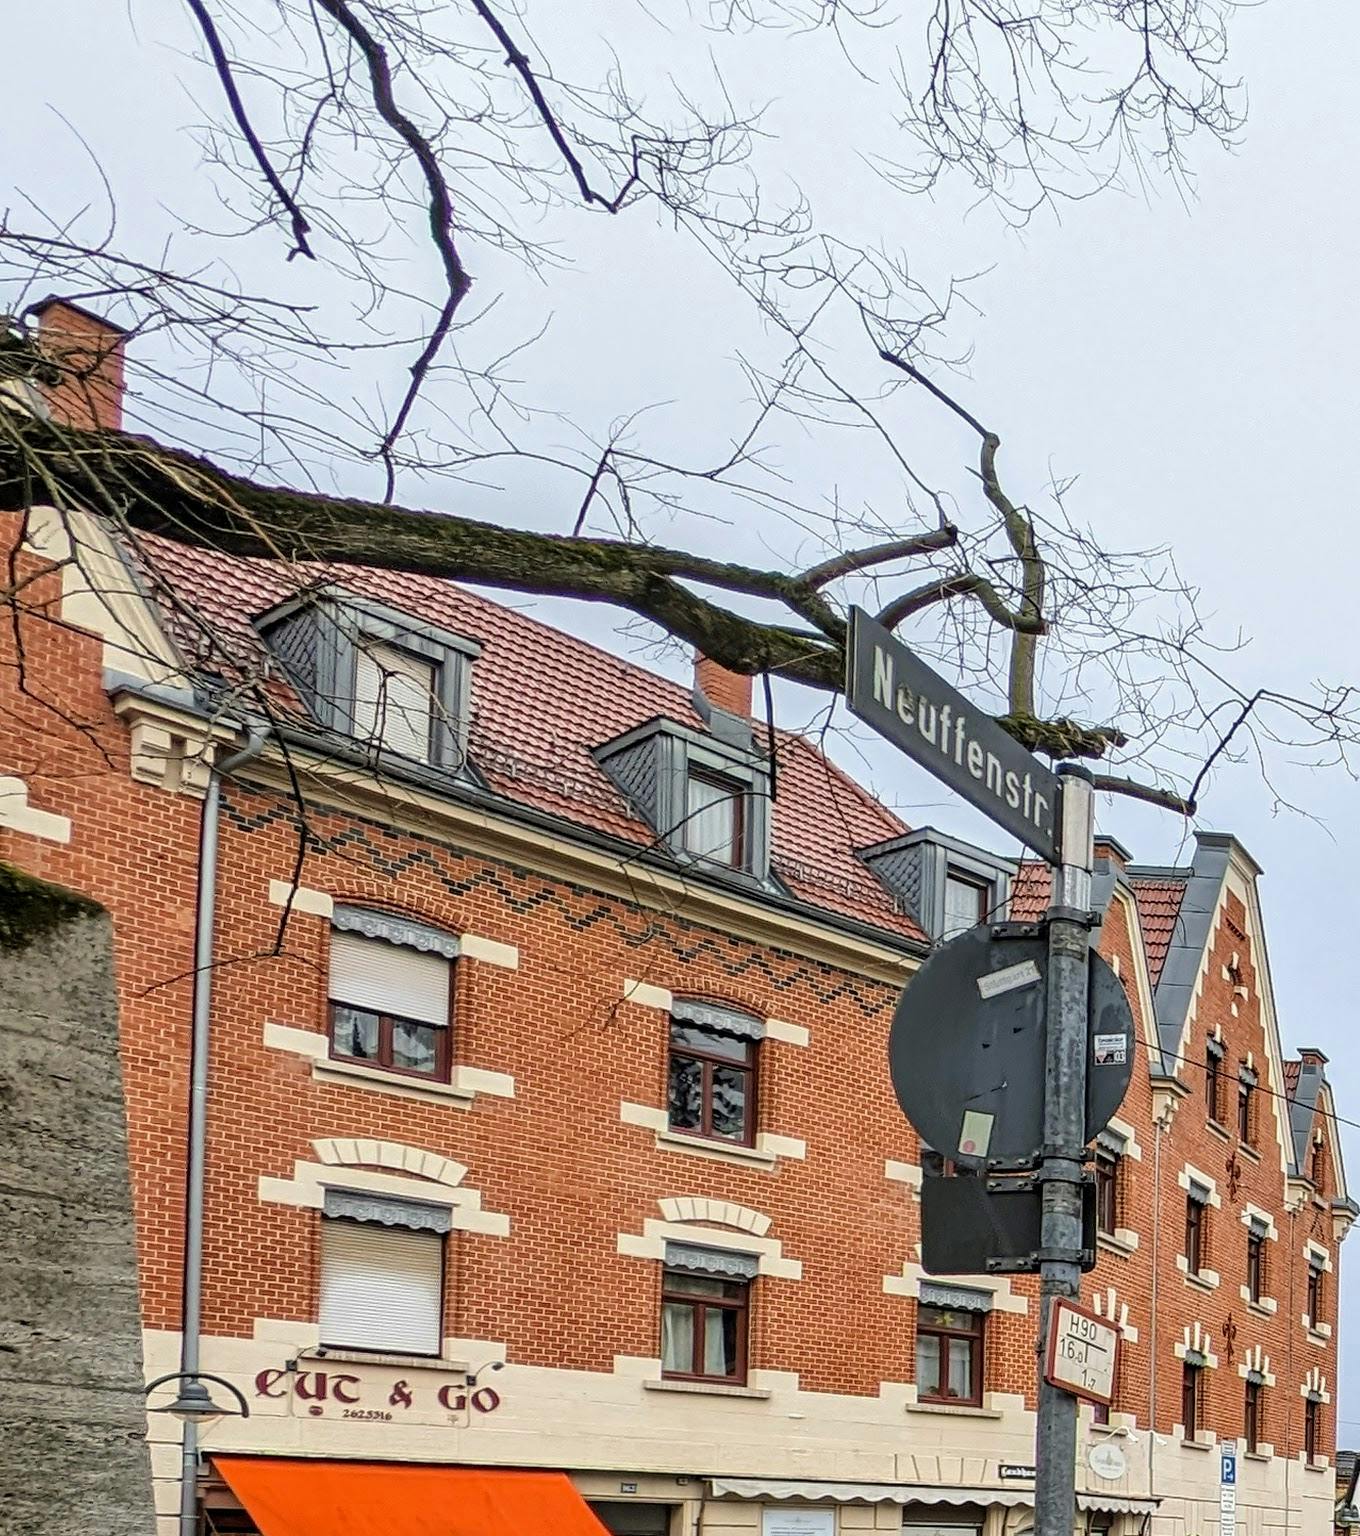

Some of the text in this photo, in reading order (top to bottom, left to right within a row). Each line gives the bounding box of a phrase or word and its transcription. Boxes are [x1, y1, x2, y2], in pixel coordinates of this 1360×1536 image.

[872, 645, 1054, 837] Neuffenstr.
[1069, 1314, 1097, 1341] H90
[389, 1379, 412, 1409] &
